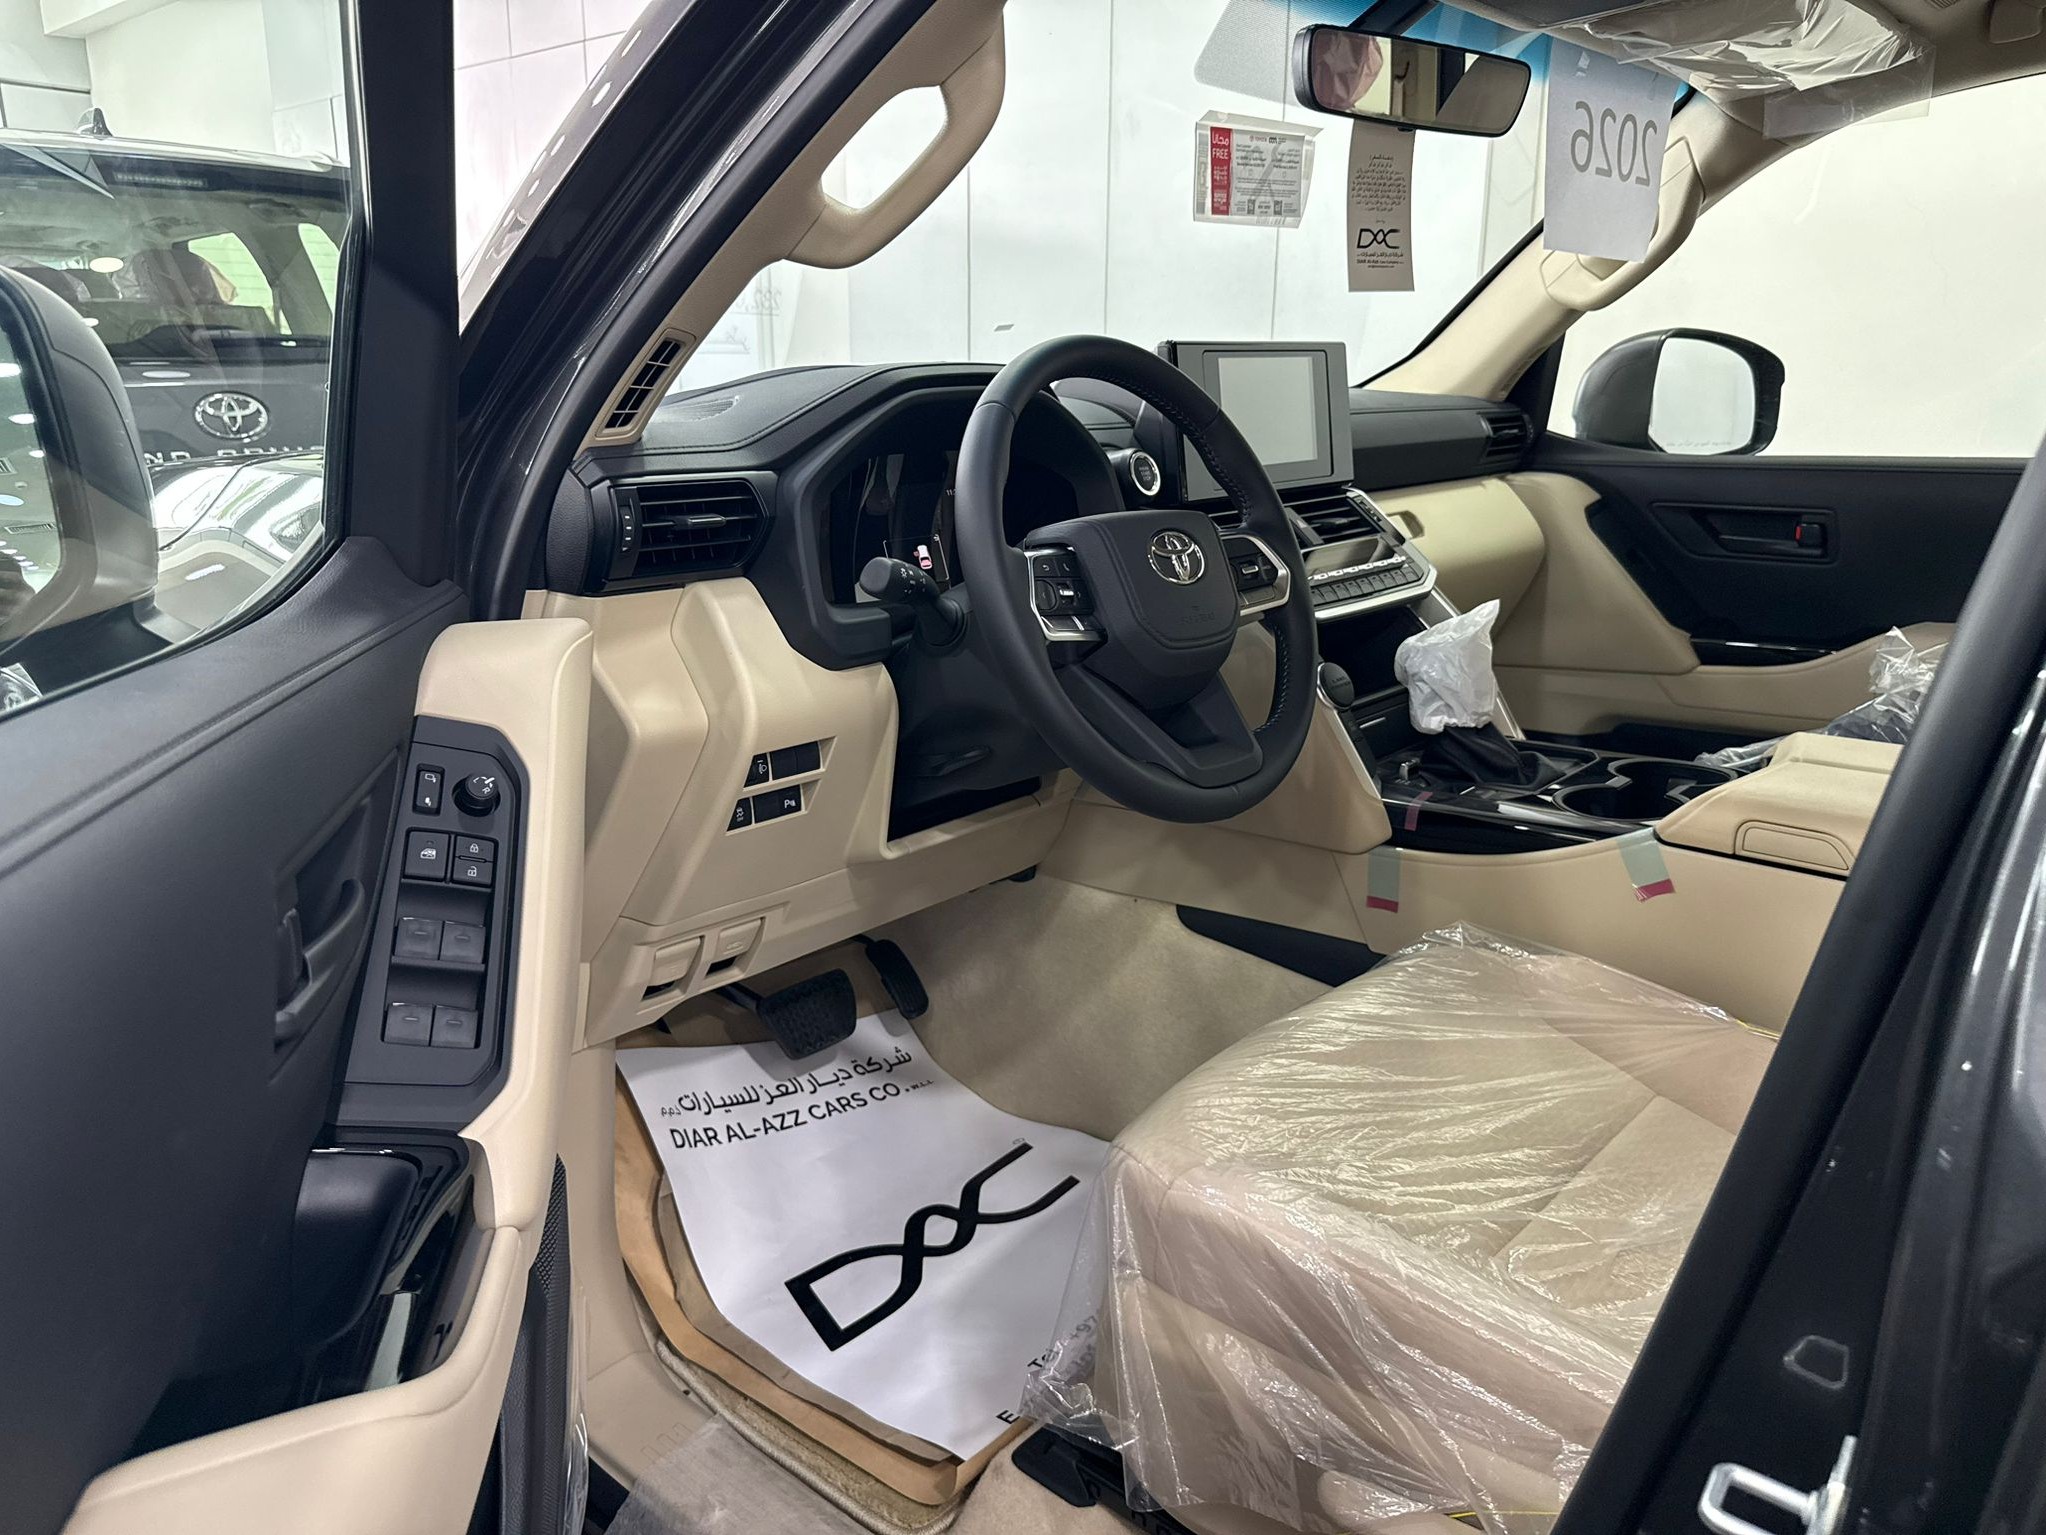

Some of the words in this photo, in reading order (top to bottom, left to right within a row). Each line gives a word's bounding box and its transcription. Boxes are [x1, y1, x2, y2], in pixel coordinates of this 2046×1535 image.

[1212, 147, 1229, 160] FREE
[851, 1046, 912, 1075] شركة
[678, 1085, 760, 1116] للسيارات
[669, 1126, 723, 1149] DIAR
[725, 1109, 808, 1143] AL-AZZ
[808, 1092, 868, 1120] CARS
